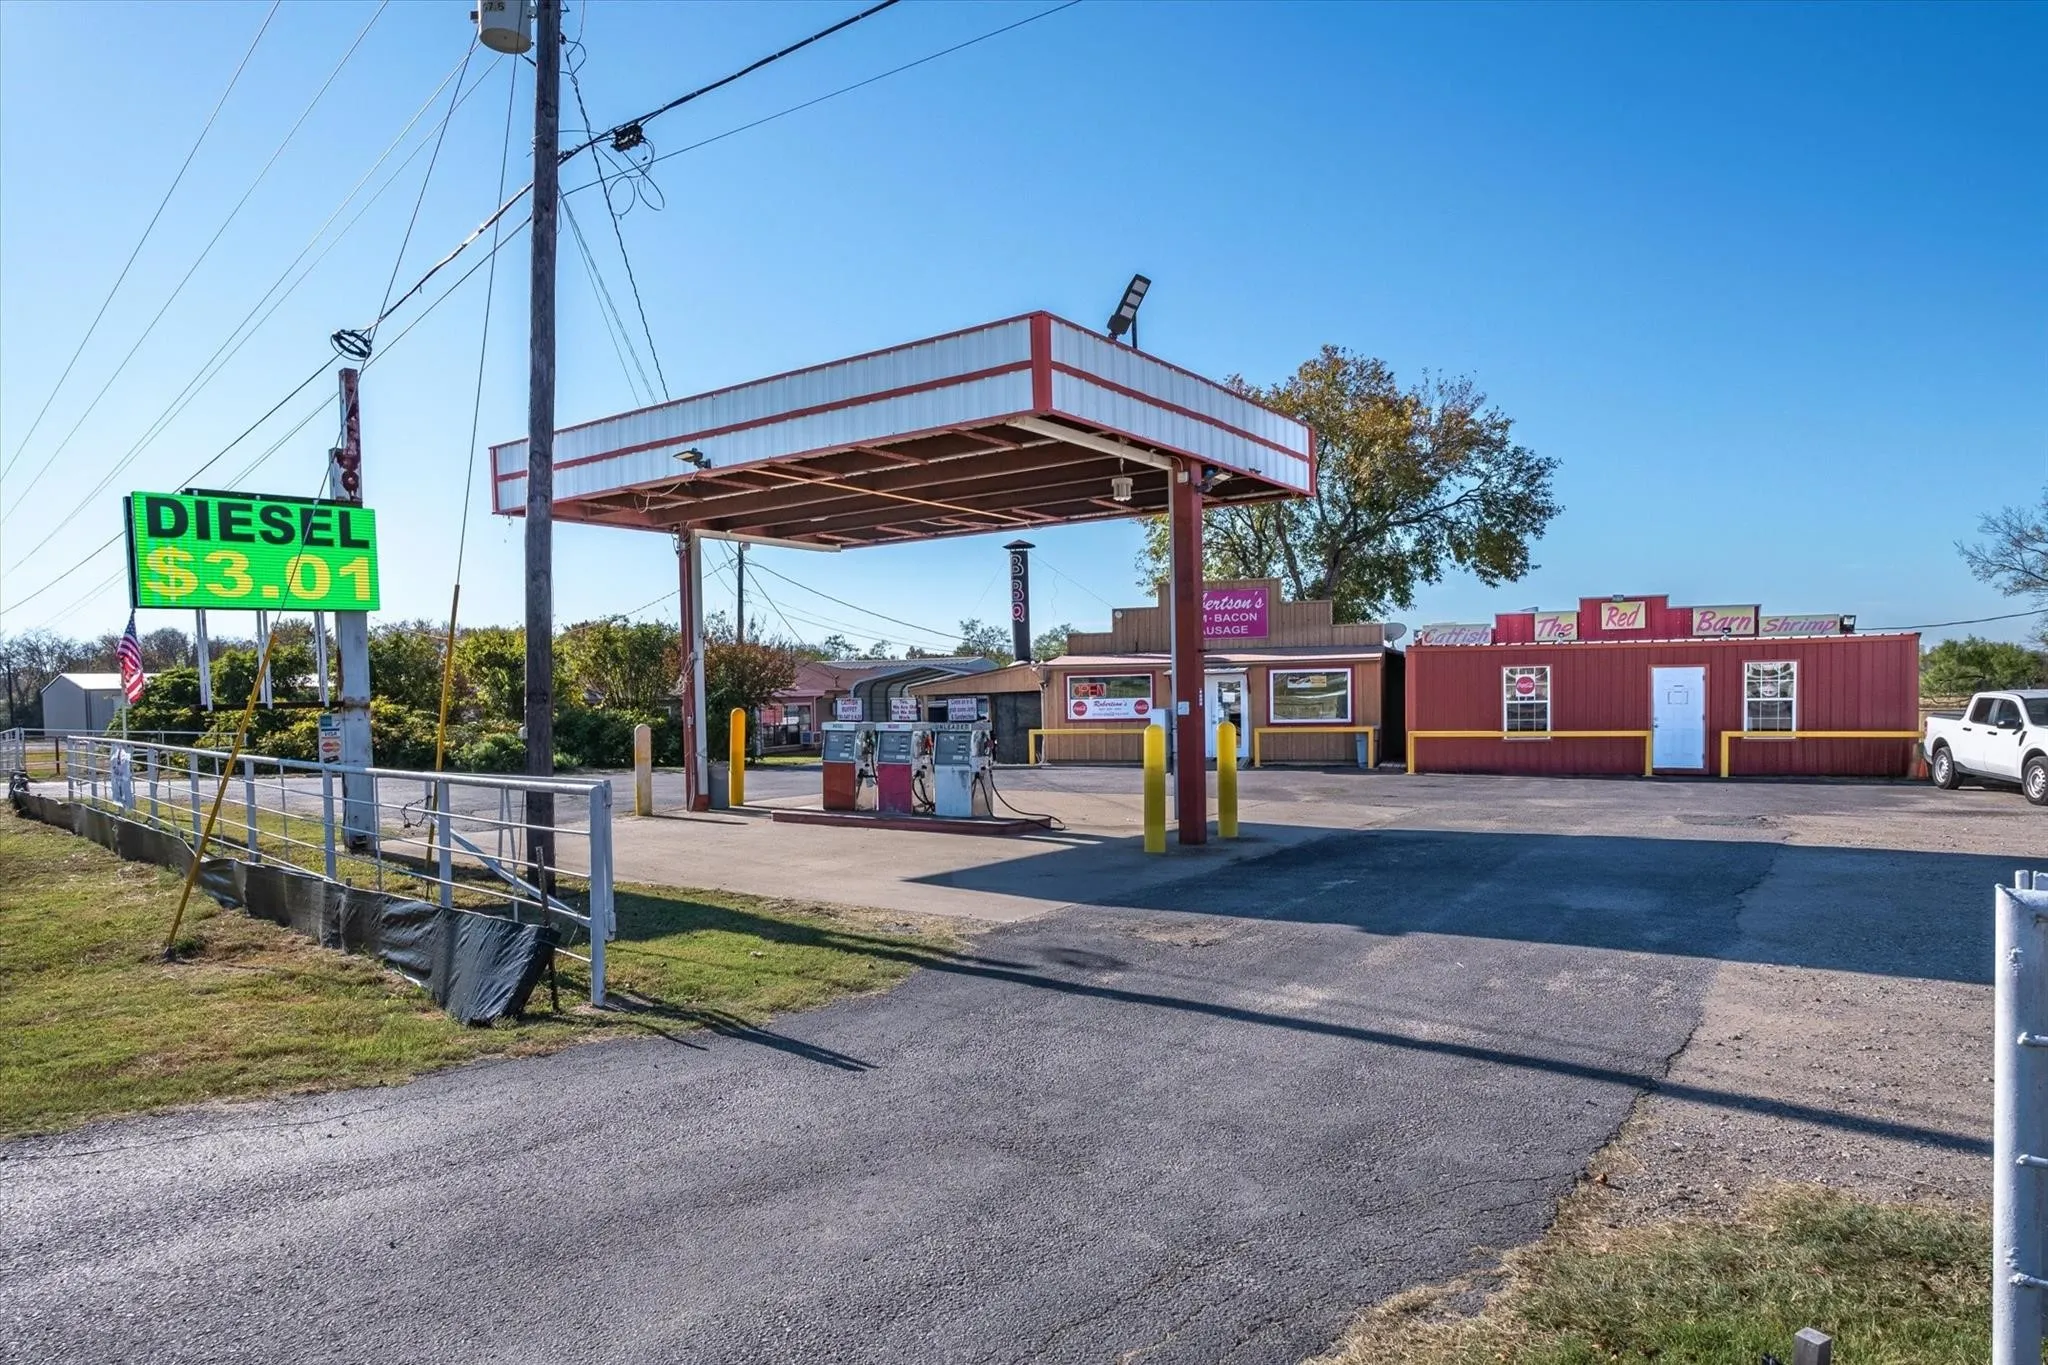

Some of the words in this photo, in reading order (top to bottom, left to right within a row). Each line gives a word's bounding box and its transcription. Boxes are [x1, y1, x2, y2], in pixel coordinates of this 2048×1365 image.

[145, 496, 370, 549] DIESEL
[146, 546, 371, 602] $3.01
[1010, 553, 1024, 622] BBQ
[1214, 612, 1257, 622] BACON
[1537, 616, 1574, 638] The
[1605, 603, 1641, 627] Red
[1695, 610, 1752, 632] Barn
[1762, 617, 1838, 633] Shrimp
[1203, 625, 1248, 635] USAGE
[1424, 626, 1490, 643] Catfish
[1074, 683, 1105, 697] OPEN
